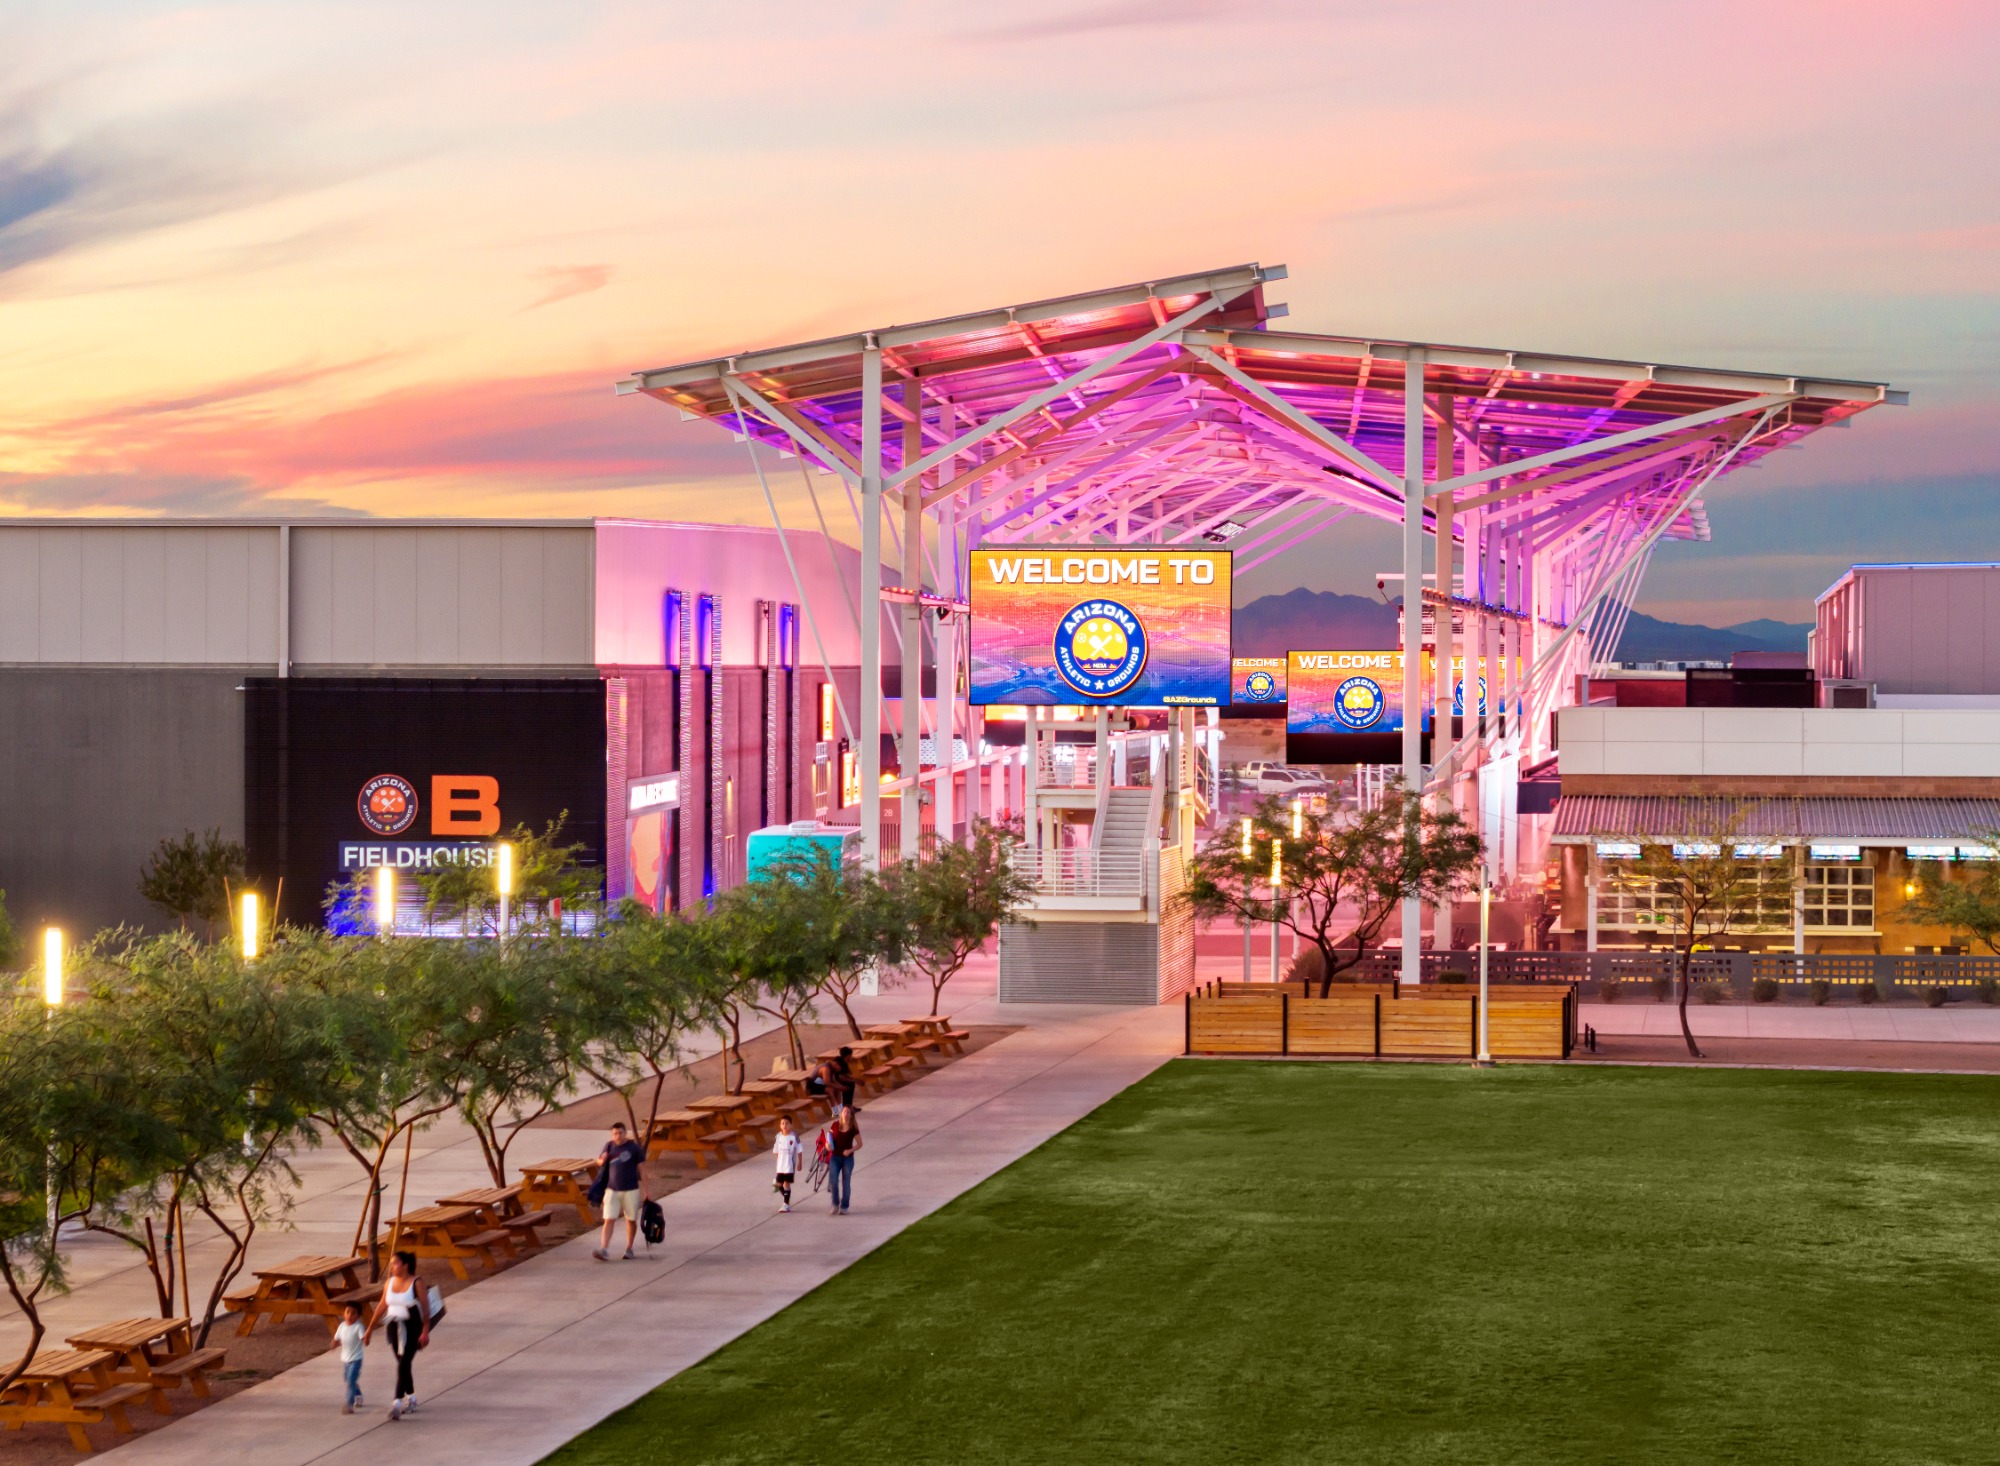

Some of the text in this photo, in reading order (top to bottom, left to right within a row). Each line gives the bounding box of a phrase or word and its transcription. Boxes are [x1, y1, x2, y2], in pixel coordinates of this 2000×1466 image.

[988, 558, 1214, 585] WELCOME TO
[1064, 603, 1136, 635] ARIZONA
[1060, 646, 1139, 687] ATHLETIC GROUNDS
[1298, 655, 1391, 669] WELCOME
[1339, 678, 1379, 696] ARIZONA
[365, 778, 411, 797] ARIZONA
[363, 804, 383, 829] ATHLETIC
[431, 775, 500, 835] B
[344, 847, 500, 867] FIELDHOUSE
